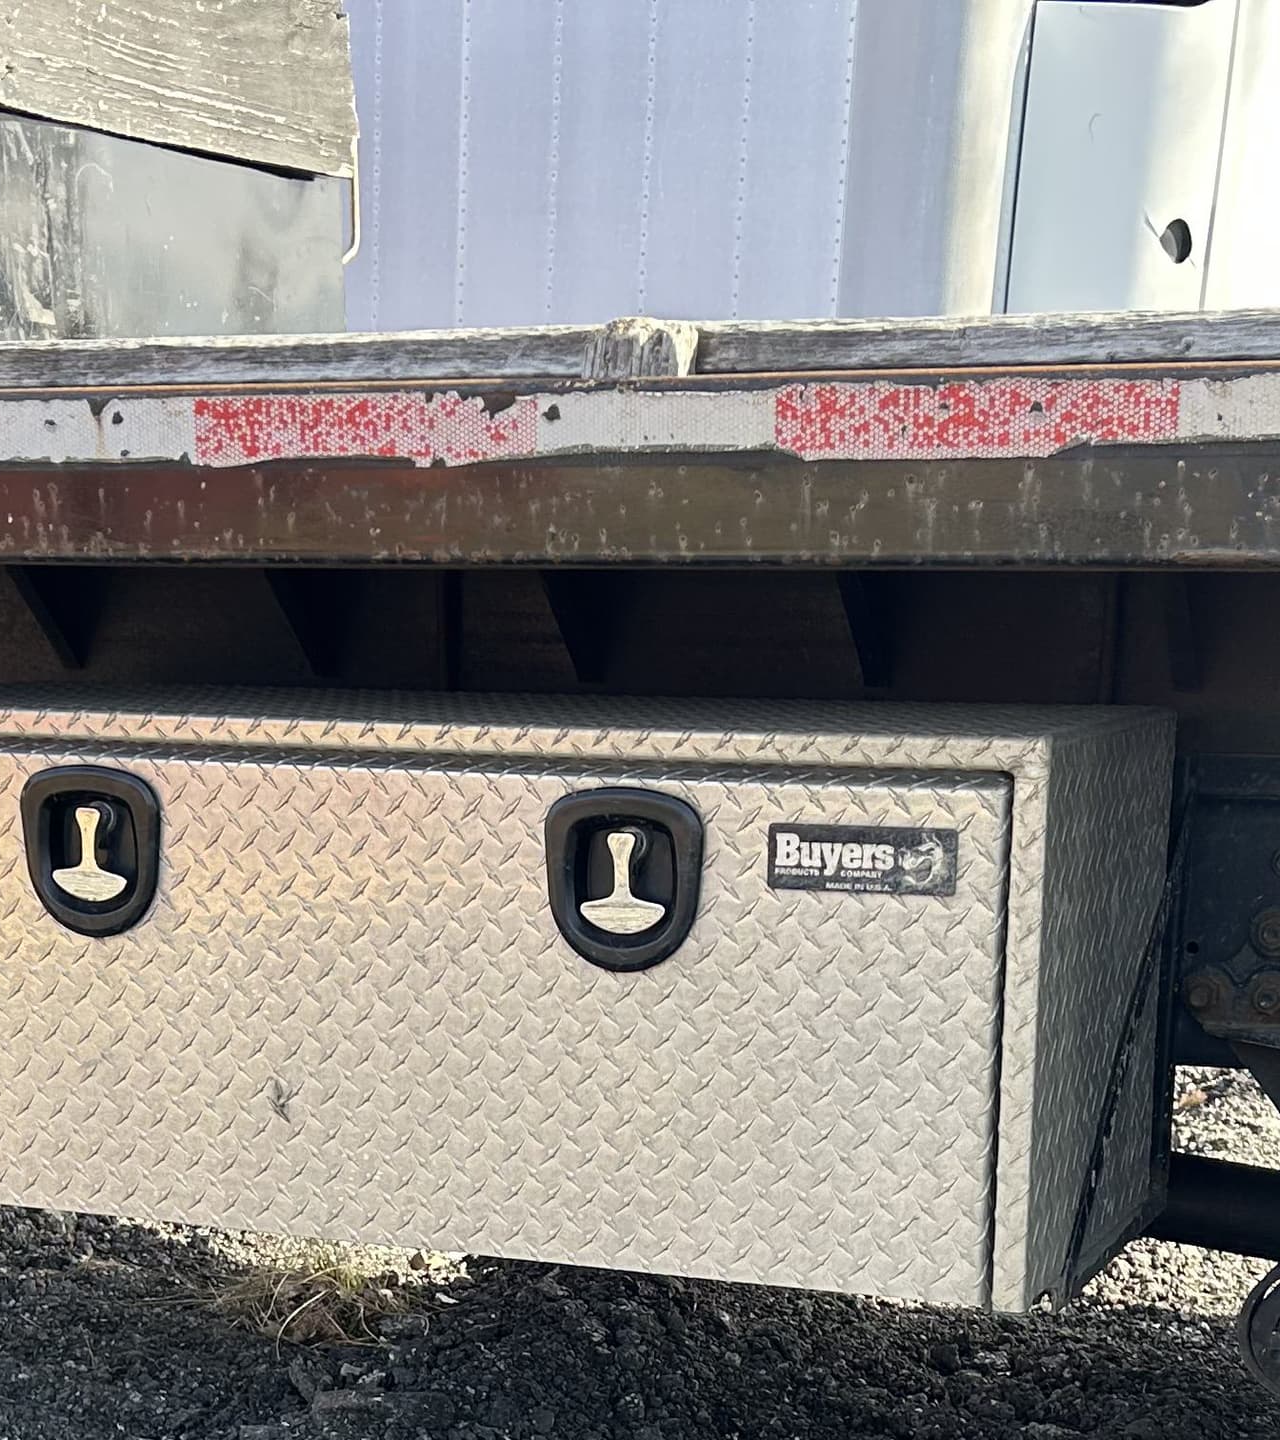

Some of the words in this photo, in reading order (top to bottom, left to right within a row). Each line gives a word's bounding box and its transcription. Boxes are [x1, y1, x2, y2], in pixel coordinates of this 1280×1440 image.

[774, 832, 895, 876] Buyers
[774, 867, 820, 876] PRODUCTS
[840, 869, 883, 878] COMPANY
[825, 881, 852, 890] MADE
[854, 882, 865, 890] IN
